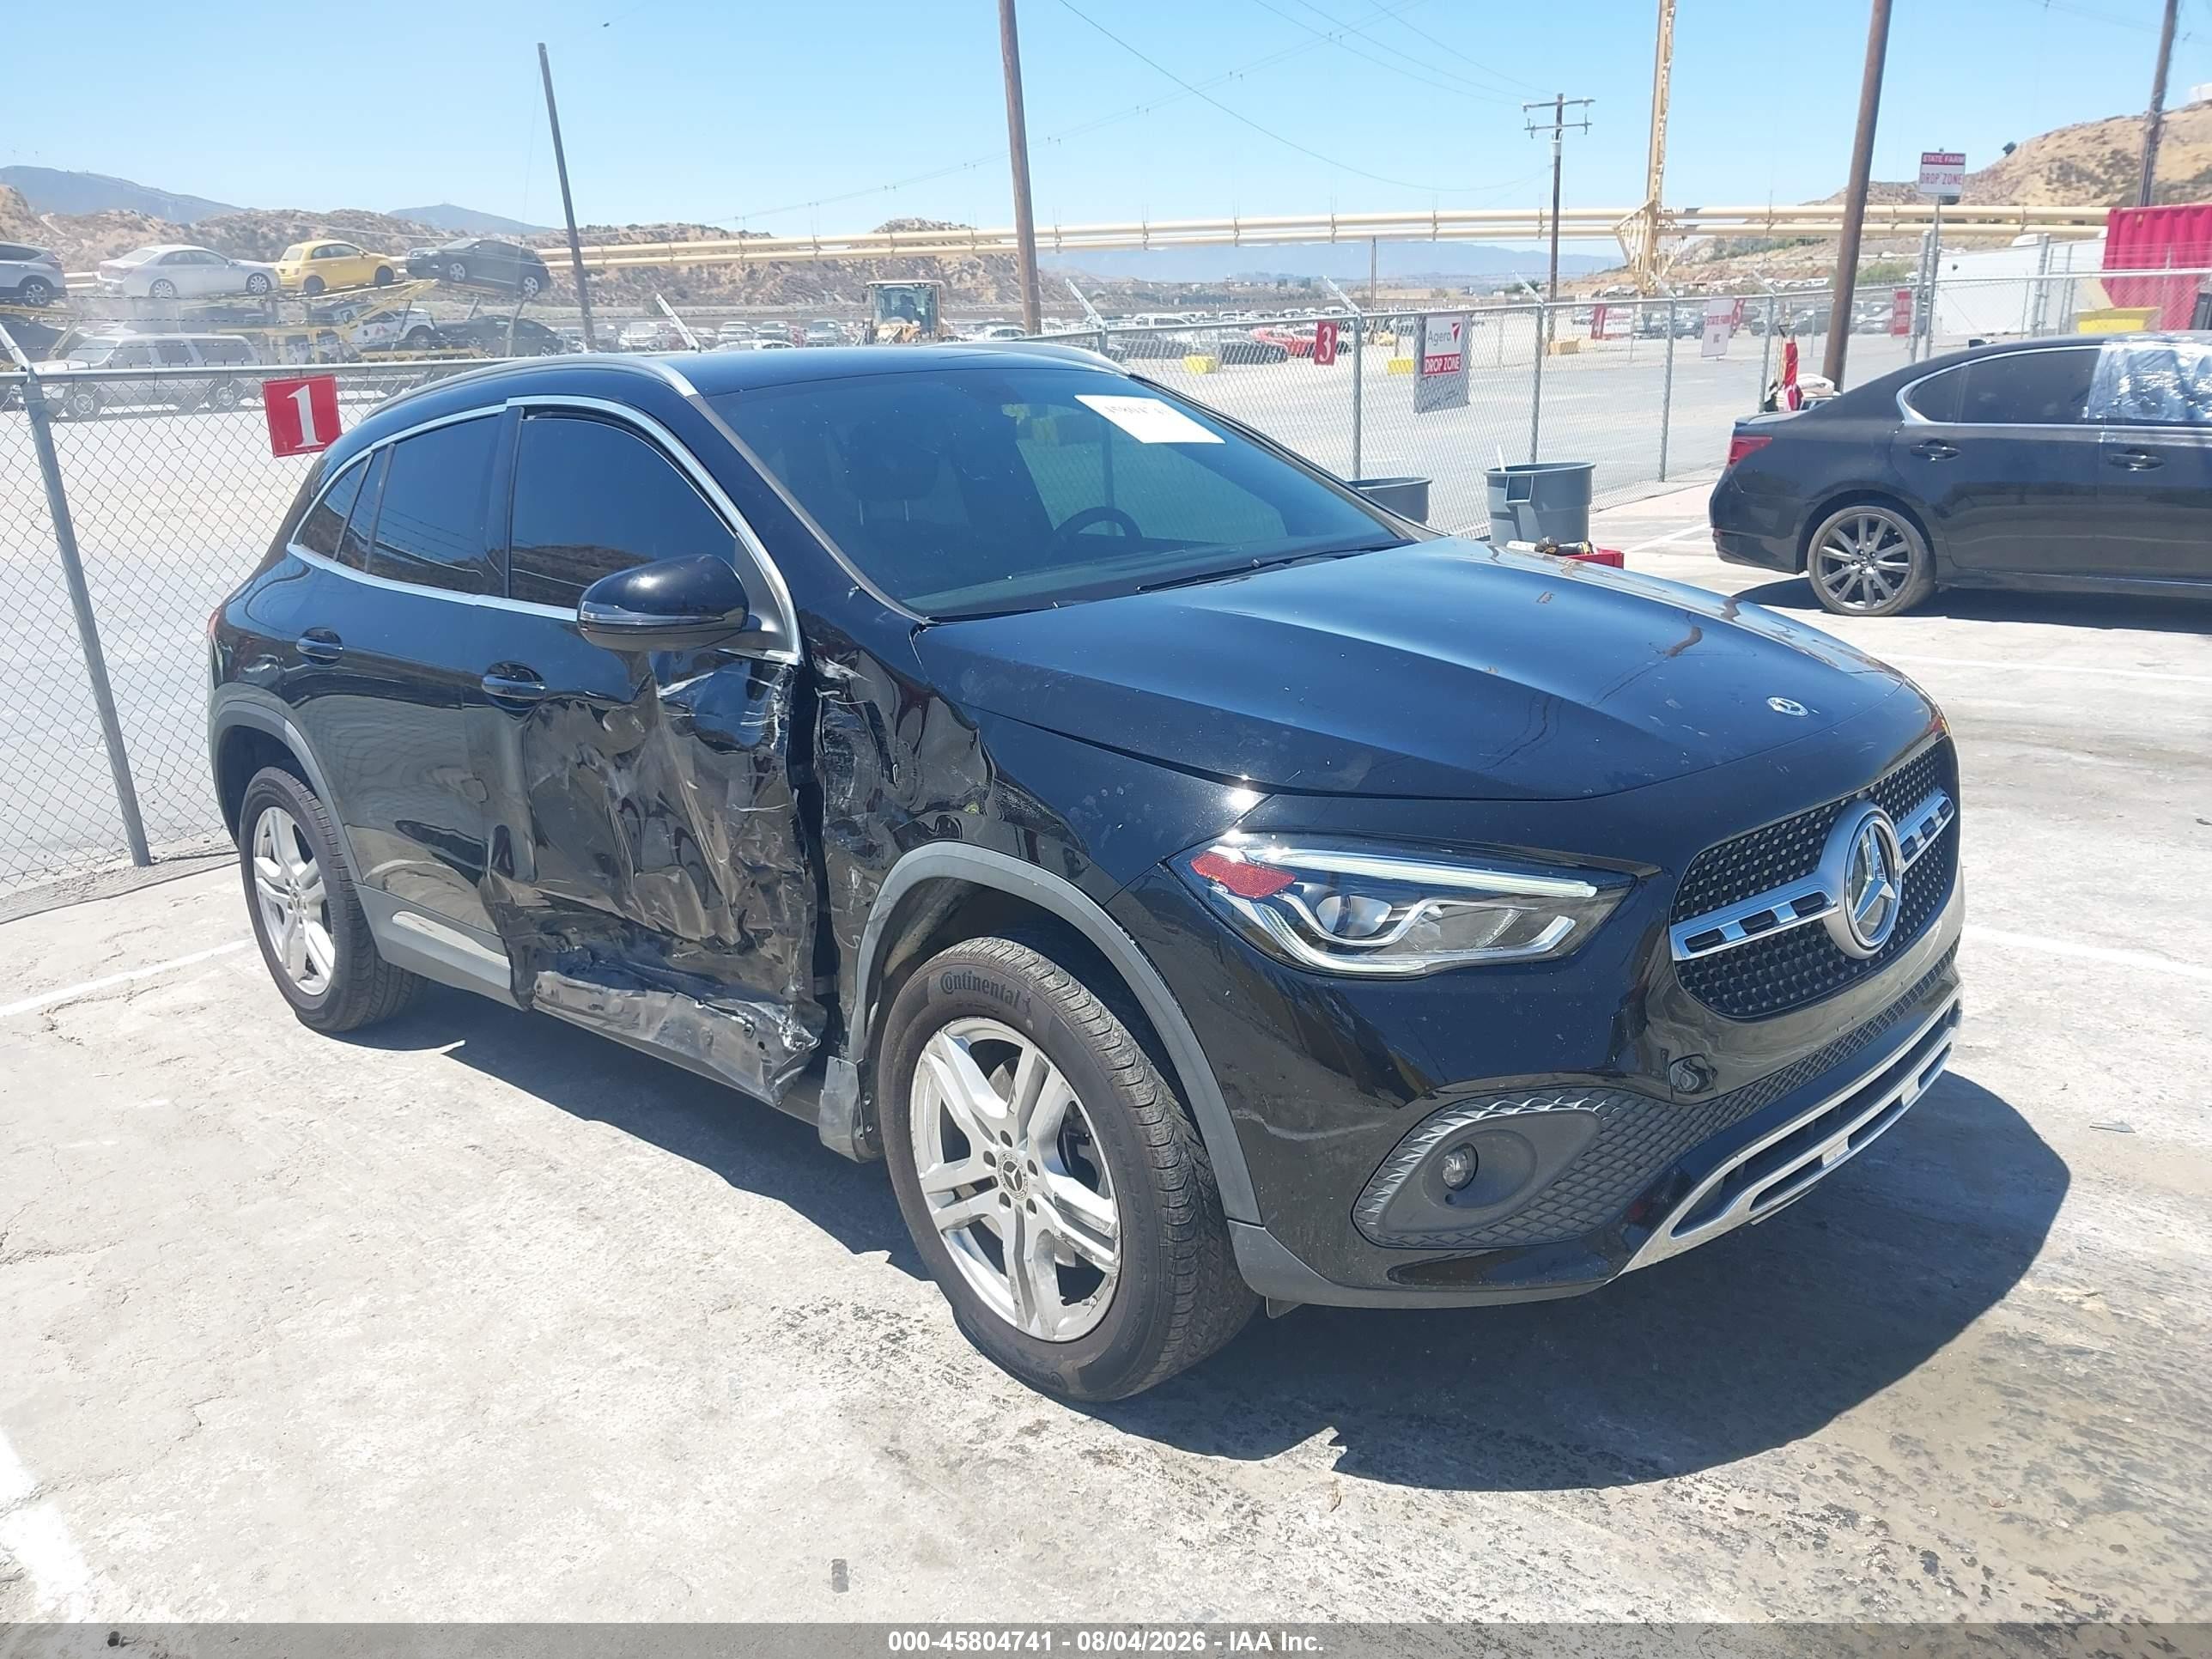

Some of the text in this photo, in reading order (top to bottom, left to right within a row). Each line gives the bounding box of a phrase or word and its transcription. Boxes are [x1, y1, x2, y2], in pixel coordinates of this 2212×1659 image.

[1923, 155, 1944, 164] STATE
[1919, 173, 1963, 185] DROP ZONE
[1319, 326, 1331, 362] 3
[1428, 330, 1451, 346] Agero
[1425, 356, 1460, 373] DROP ZONE
[287, 384, 325, 448] 1
[940, 969, 1022, 1010] Continental
